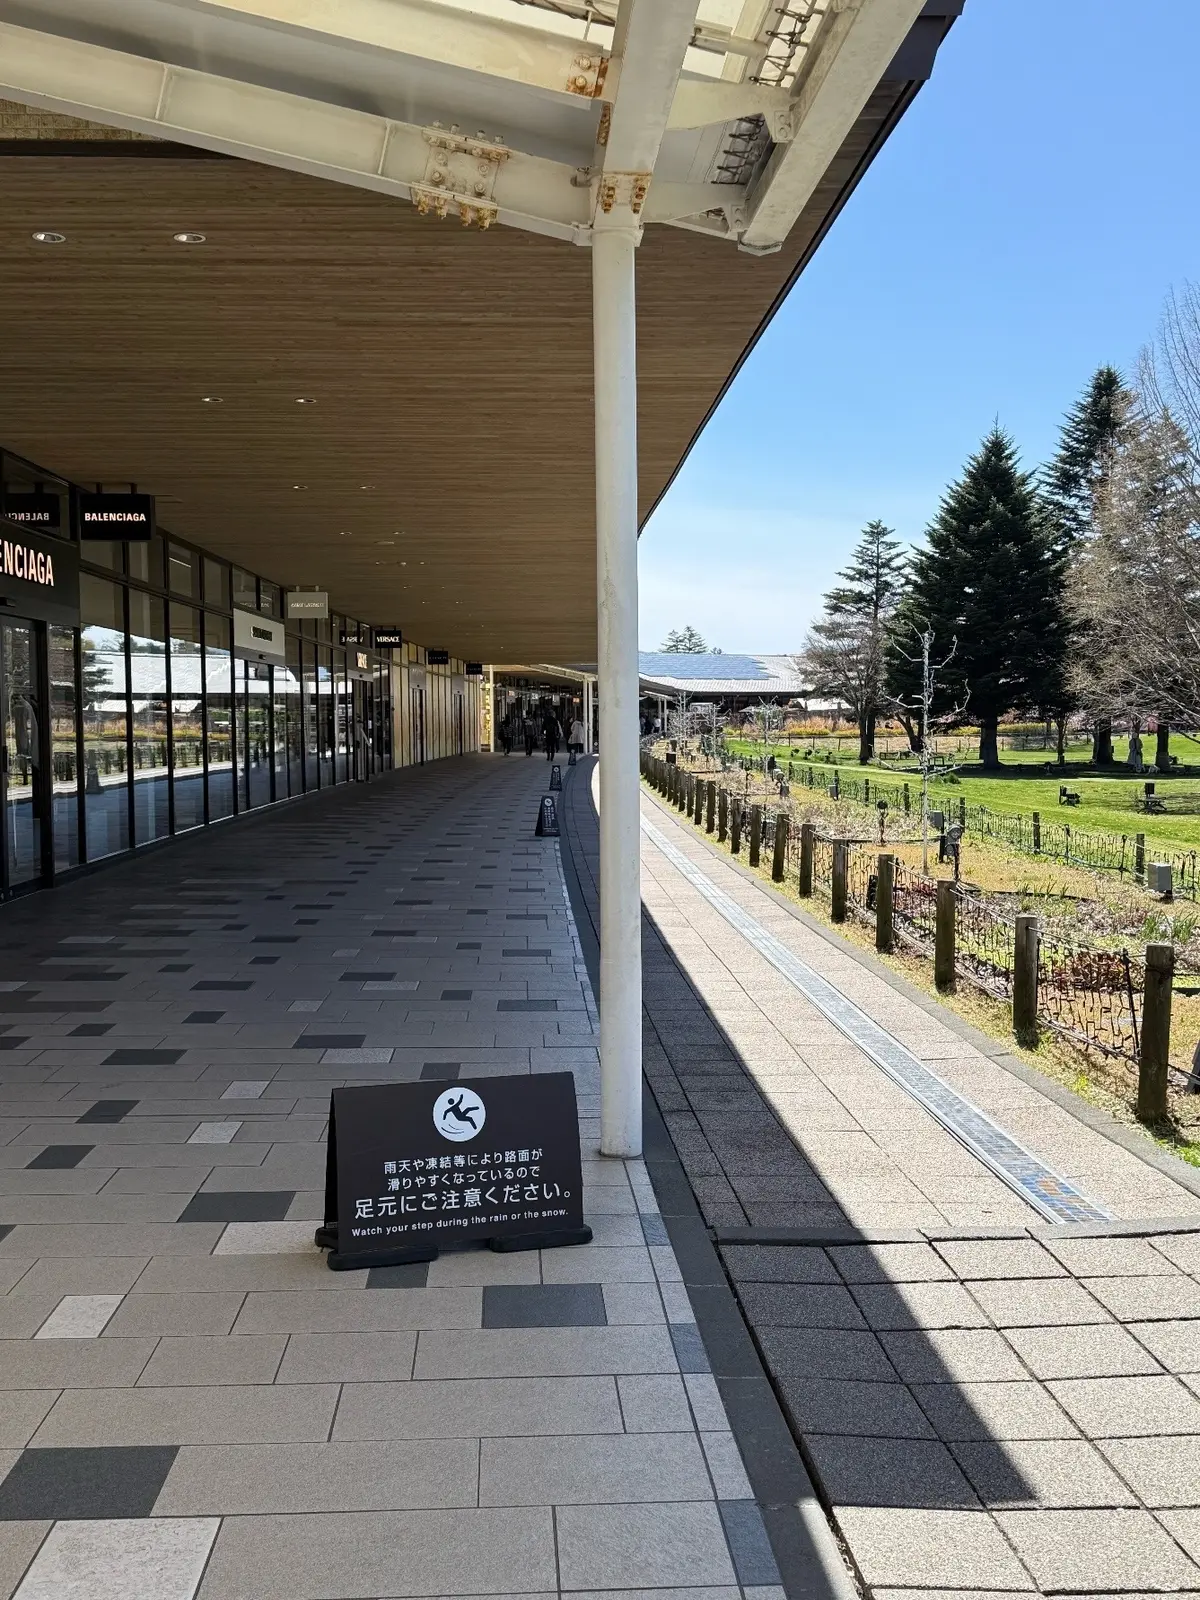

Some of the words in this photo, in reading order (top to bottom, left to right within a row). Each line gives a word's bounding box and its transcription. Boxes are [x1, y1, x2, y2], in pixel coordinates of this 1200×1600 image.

[84, 512, 146, 522] BALENCIAGA
[384, 1148, 543, 1174] 雨天や凍結等により路面が
[387, 1166, 541, 1192] 滑りやすくなっているので
[355, 1183, 571, 1219] 足元にご注意ください。
[351, 1226, 383, 1237] Watch
[385, 1224, 409, 1236] your
[411, 1221, 434, 1233] step
[436, 1217, 468, 1230] during
[471, 1215, 486, 1224] the
[489, 1213, 508, 1222] rain
[524, 1210, 539, 1218] the
[541, 1207, 569, 1217] snow.
